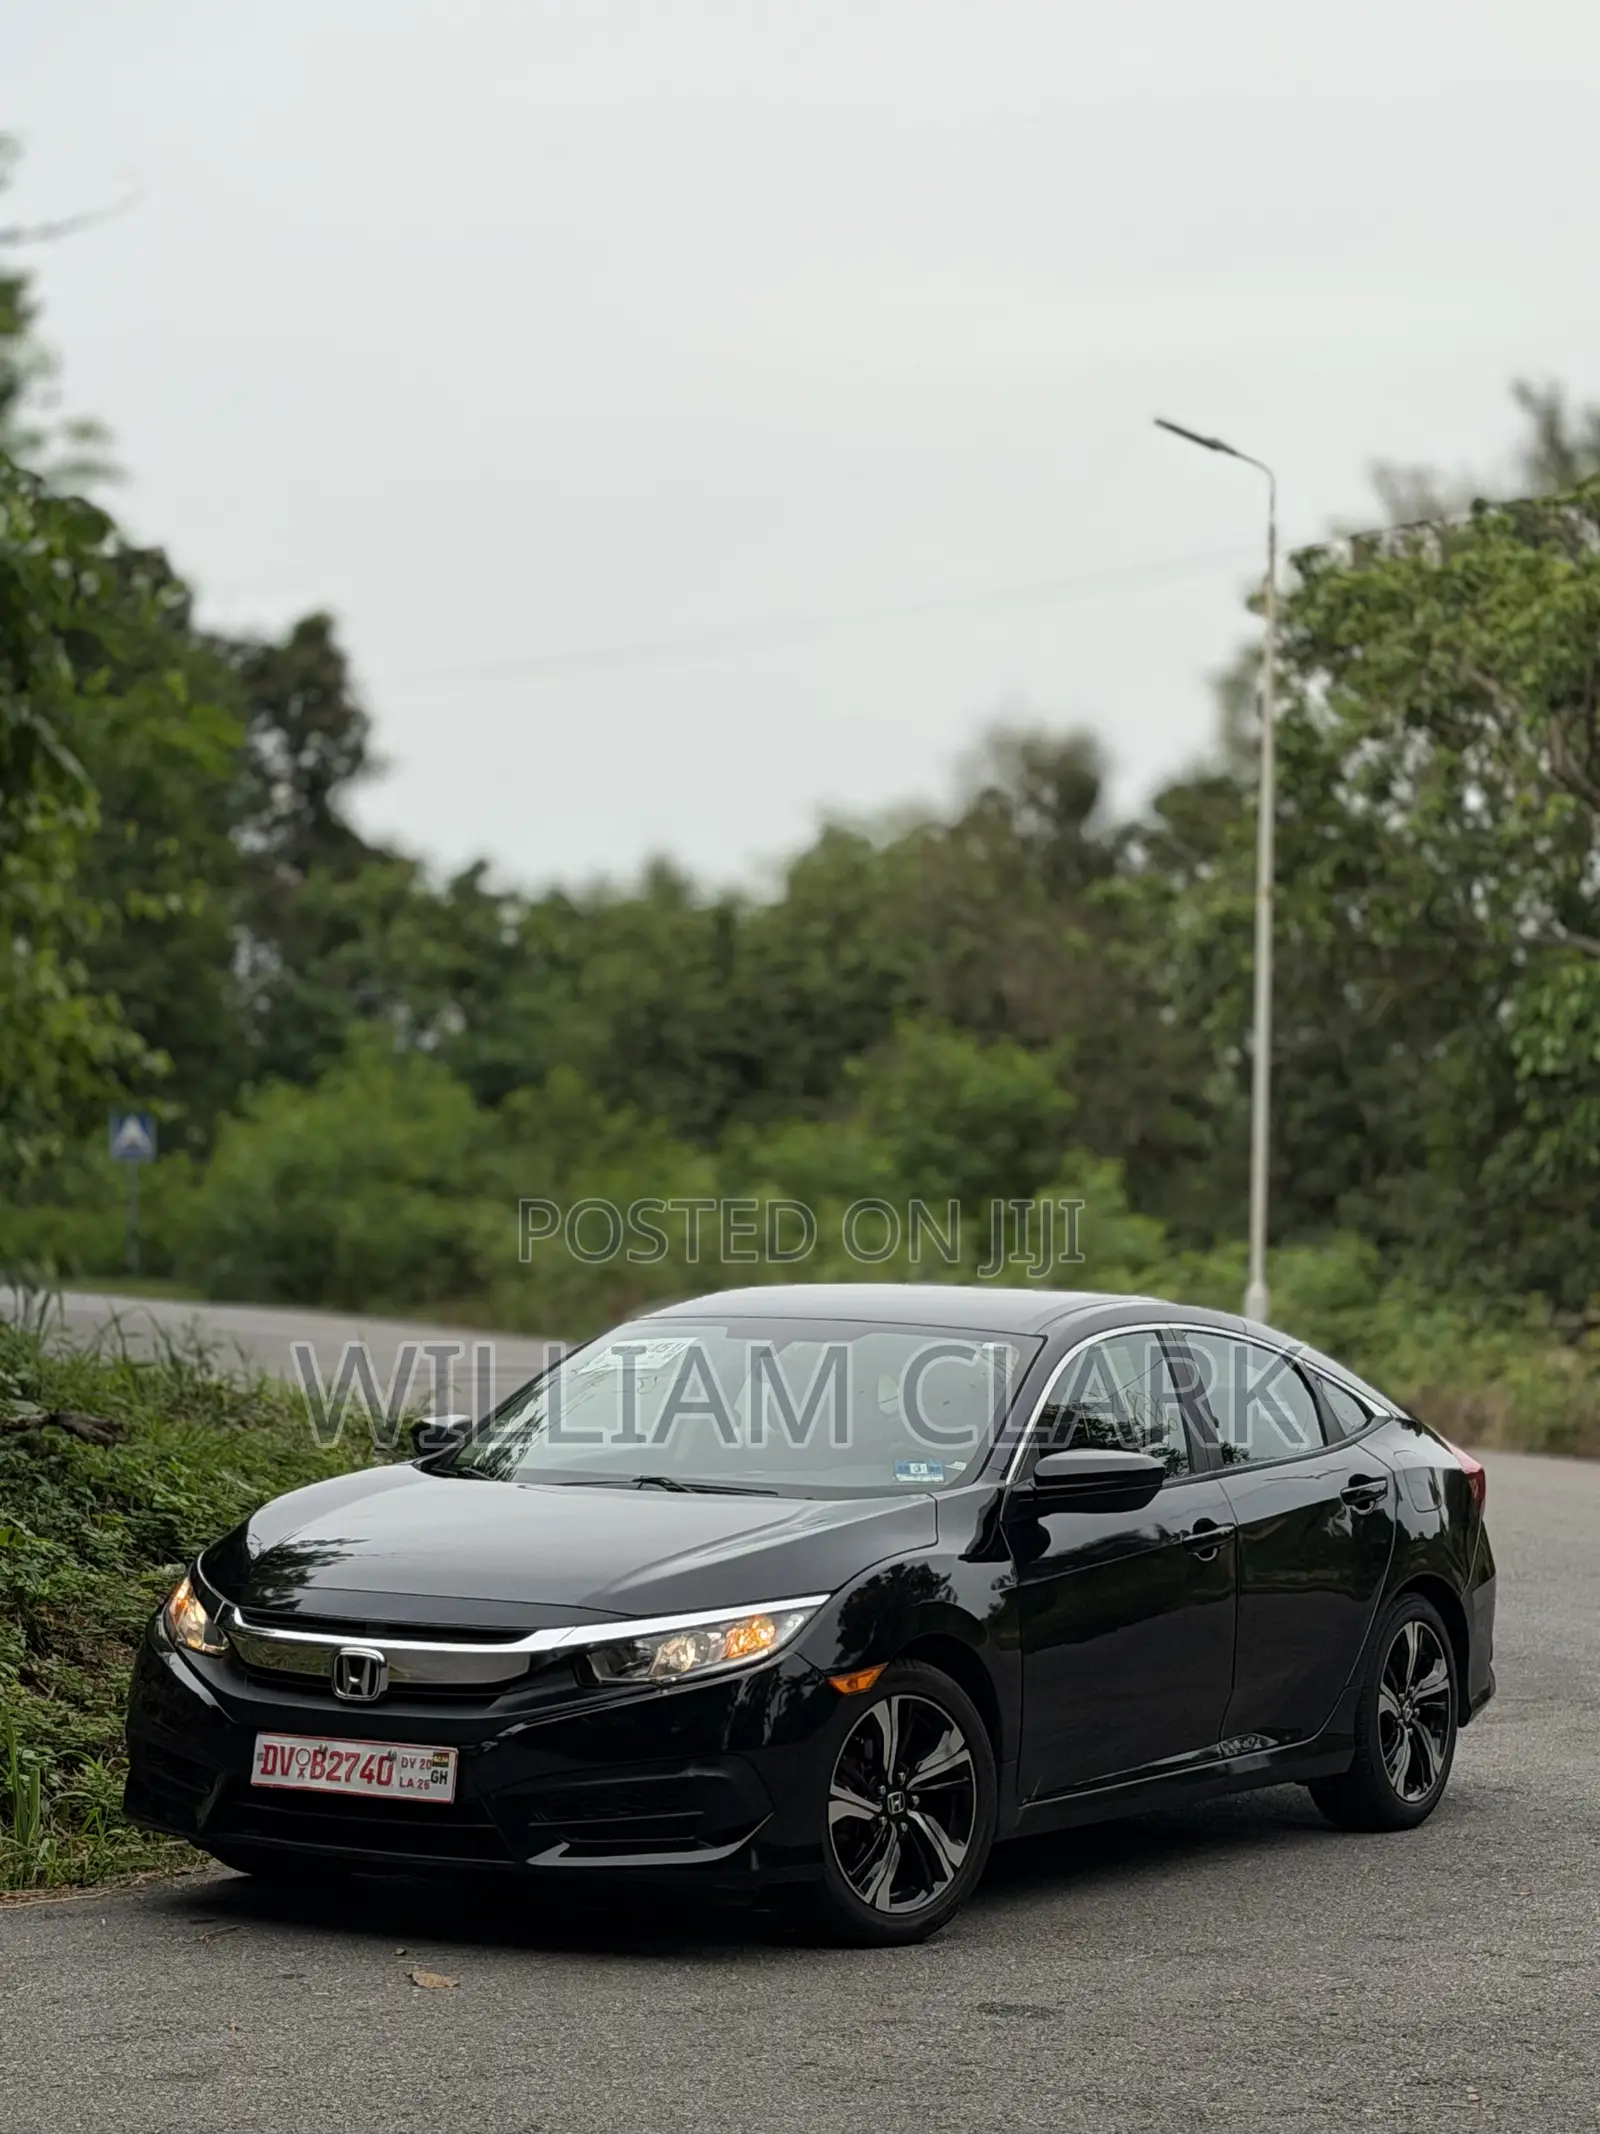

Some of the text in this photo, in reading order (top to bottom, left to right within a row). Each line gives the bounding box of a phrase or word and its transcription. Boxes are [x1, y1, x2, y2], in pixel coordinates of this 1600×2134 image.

[400, 1756, 432, 1770] DV 20
[399, 1775, 415, 1789] LA
[430, 1769, 448, 1785] GH
